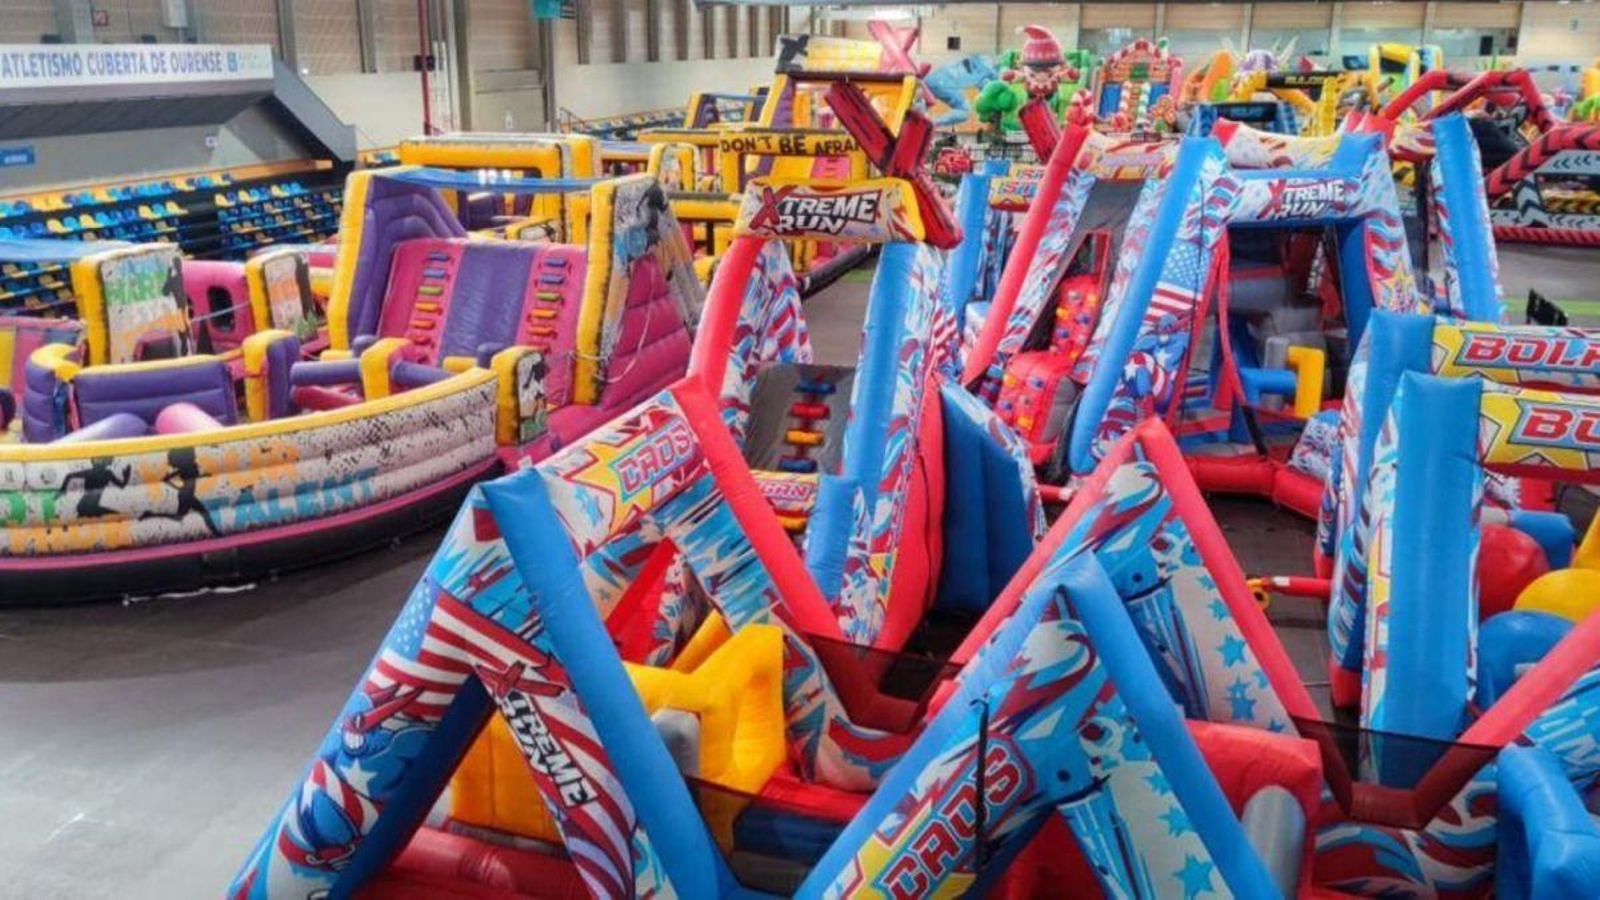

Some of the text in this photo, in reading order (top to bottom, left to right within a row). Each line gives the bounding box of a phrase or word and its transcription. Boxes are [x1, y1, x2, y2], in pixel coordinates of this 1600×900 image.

[2, 51, 82, 78] ATLETISMO
[87, 52, 147, 76] CUBERTA
[150, 53, 168, 74] DE
[170, 52, 223, 73] OURENSE
[720, 133, 860, 155] DON'T BE AFRAI
[750, 184, 882, 230] XTREME
[1256, 179, 1345, 219] XTREME
[1280, 201, 1325, 218] RUN
[779, 213, 847, 235] RUN
[474, 659, 598, 808] XTREME
